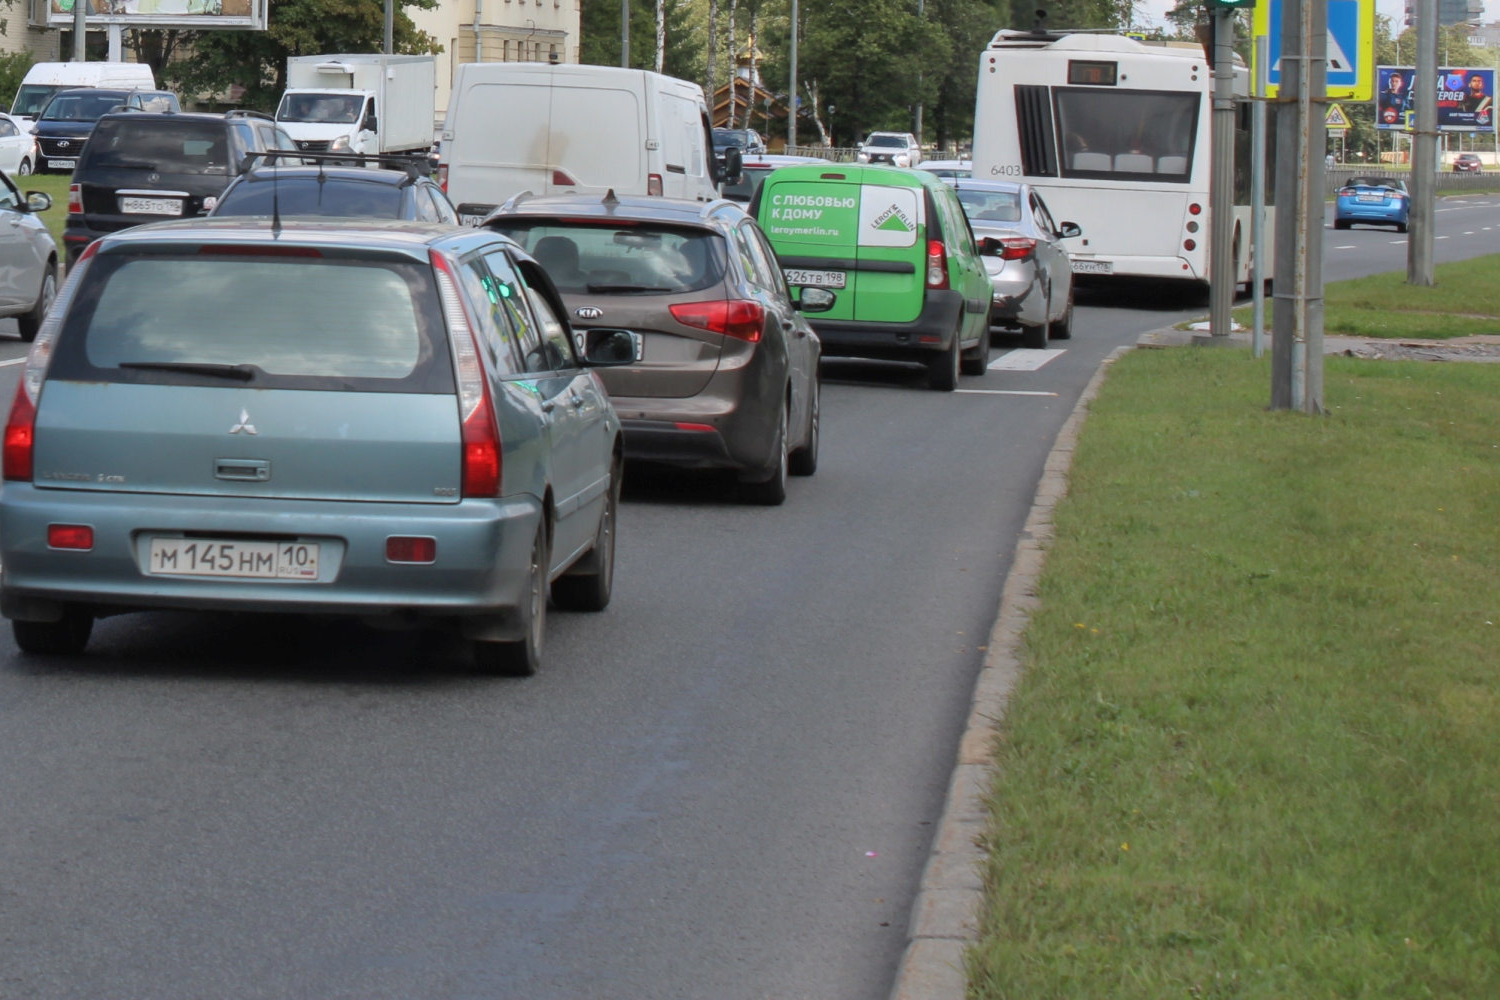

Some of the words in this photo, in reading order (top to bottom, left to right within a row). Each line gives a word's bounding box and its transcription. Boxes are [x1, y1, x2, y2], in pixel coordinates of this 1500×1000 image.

[990, 165, 1021, 177] 6403
[772, 194, 781, 205] С
[782, 195, 856, 209] ЛЮБОВЬЮ
[771, 208, 780, 218] К
[781, 208, 823, 221] ДОМУ
[770, 225, 840, 237] leroymerlin.ru
[825, 271, 843, 283] 198
[577, 308, 598, 319] KIA
[282, 544, 309, 567] 10
